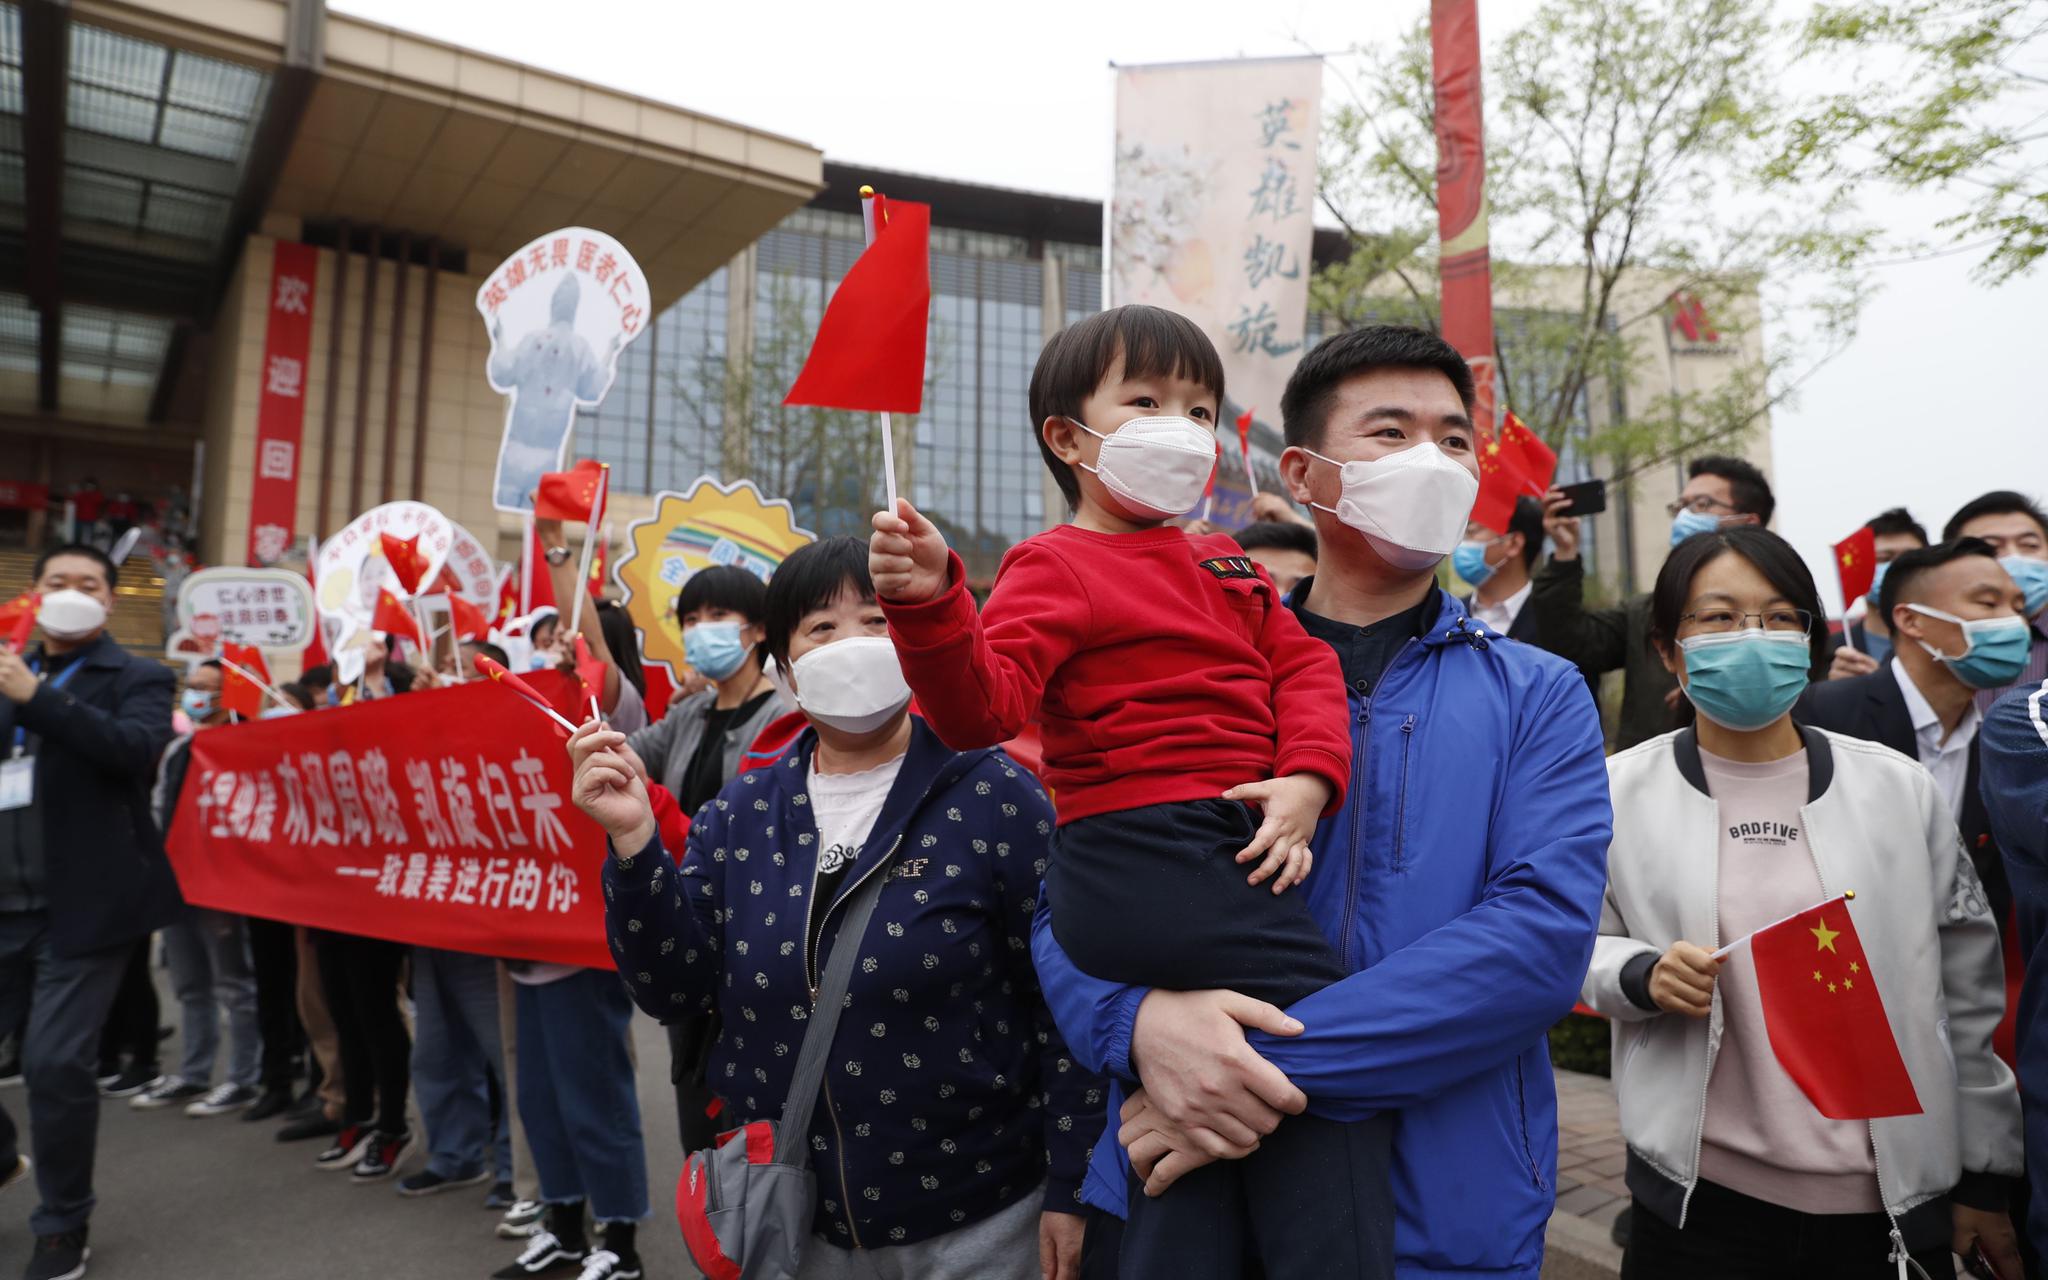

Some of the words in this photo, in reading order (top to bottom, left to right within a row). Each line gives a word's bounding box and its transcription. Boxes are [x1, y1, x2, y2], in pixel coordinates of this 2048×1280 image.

[1226, 97, 1303, 359] 英雄凯旋
[482, 238, 569, 314] 英雄无畏
[577, 239, 642, 335] 医者仁心
[254, 275, 309, 563] 欢迎回家
[405, 747, 573, 854] 凯旋归来
[1729, 821, 1798, 841] BADFIVE
